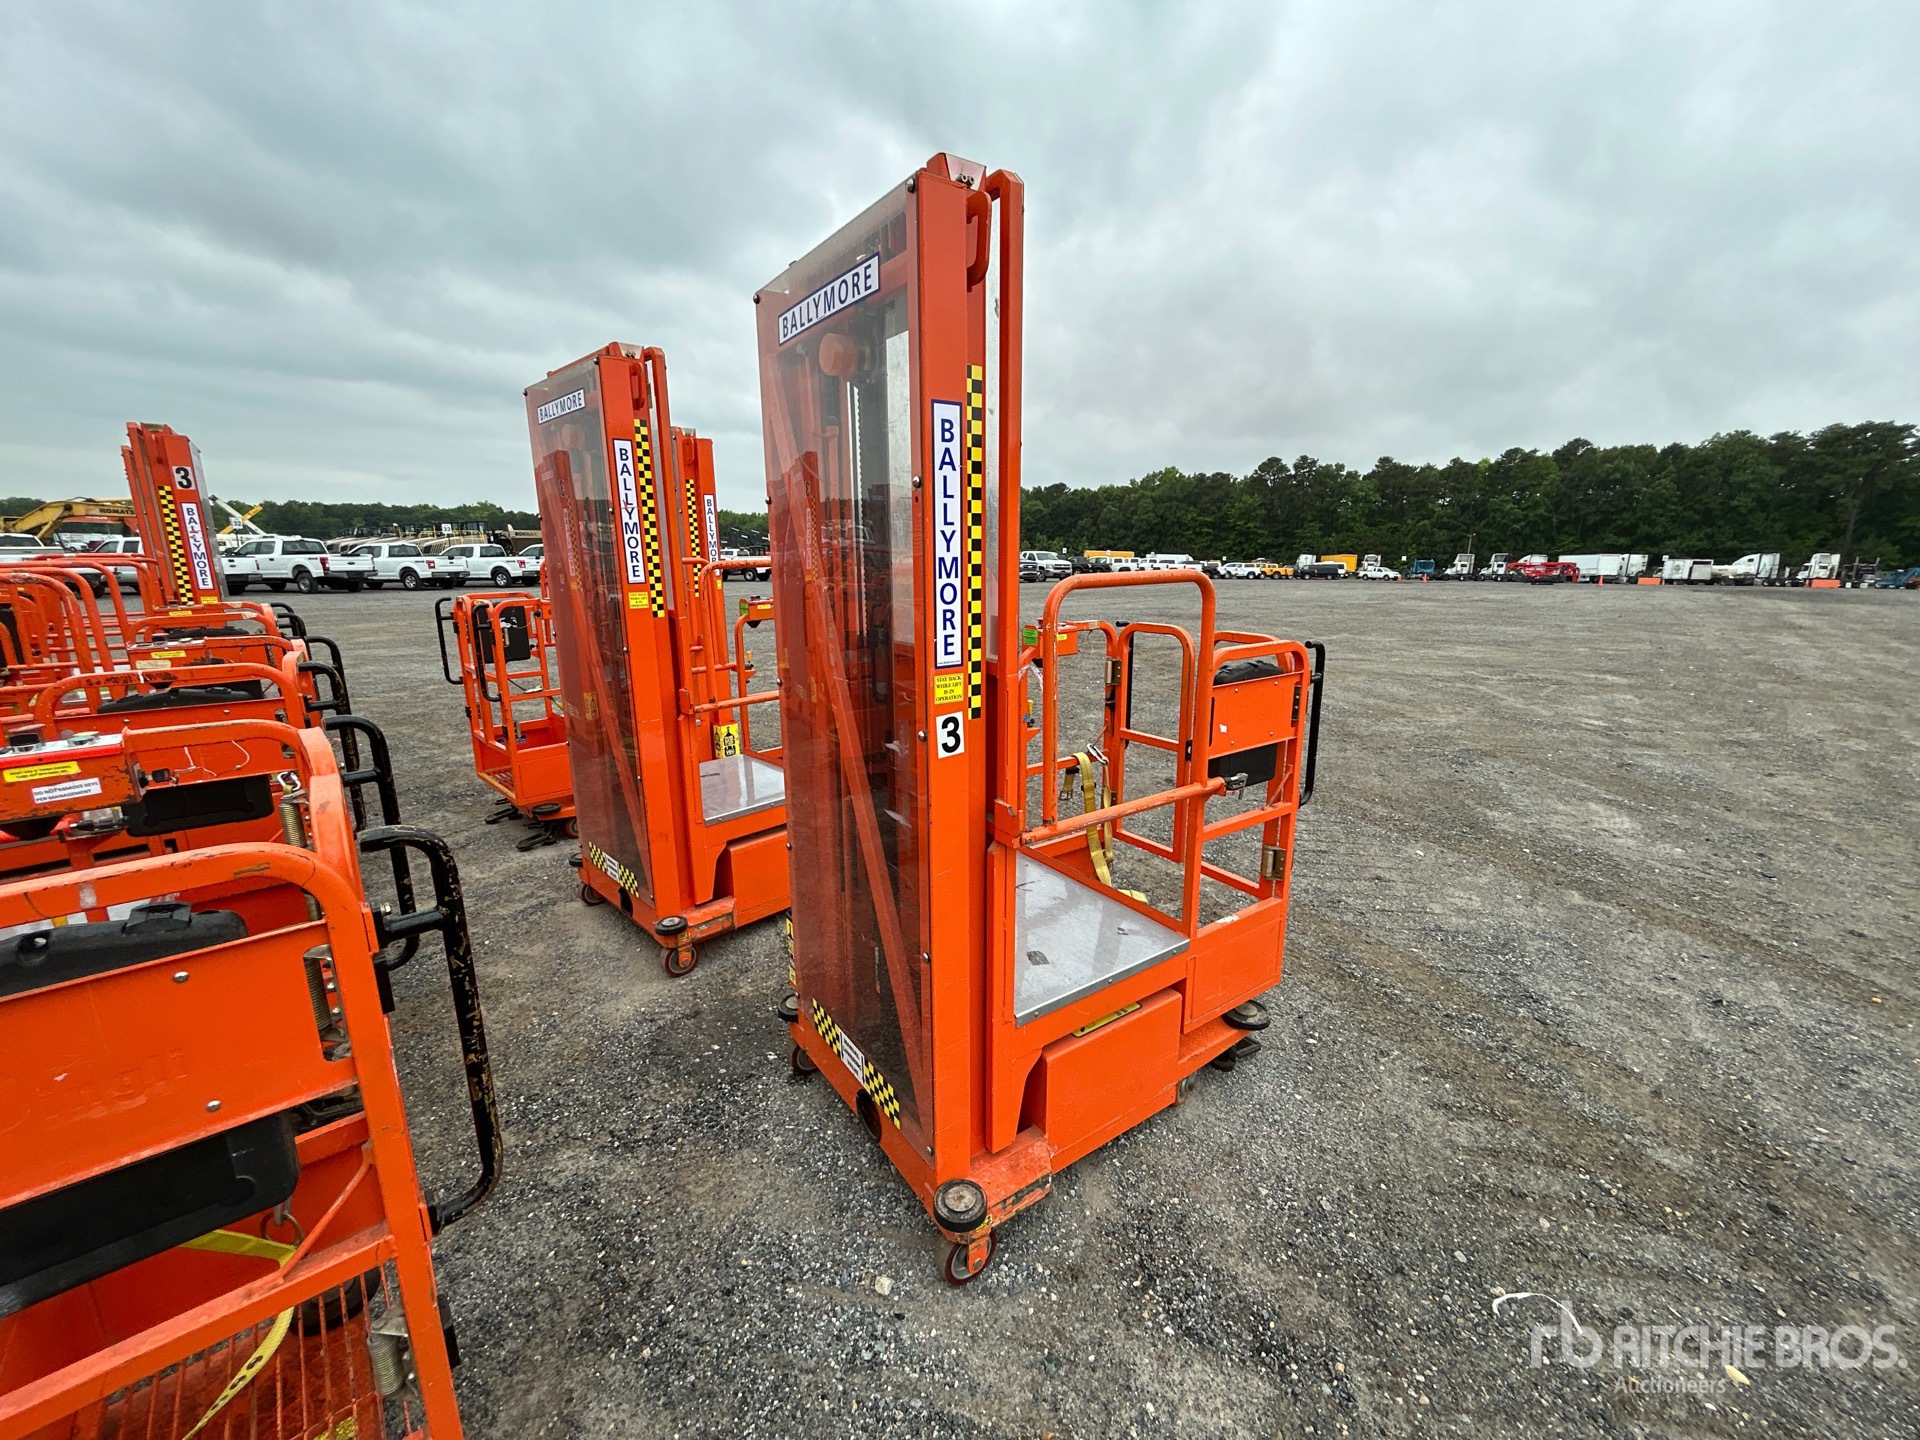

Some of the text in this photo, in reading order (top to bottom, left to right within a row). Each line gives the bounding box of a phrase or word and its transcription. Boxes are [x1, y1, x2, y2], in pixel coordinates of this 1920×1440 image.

[783, 263, 874, 339] BALLYMORE
[539, 392, 583, 421] BALLYMORE
[175, 467, 192, 488] 3
[619, 448, 640, 578] BALLYMORE
[187, 508, 209, 586] BALLYMORE
[938, 418, 959, 656] BALLYMORE
[941, 716, 961, 753] 3
